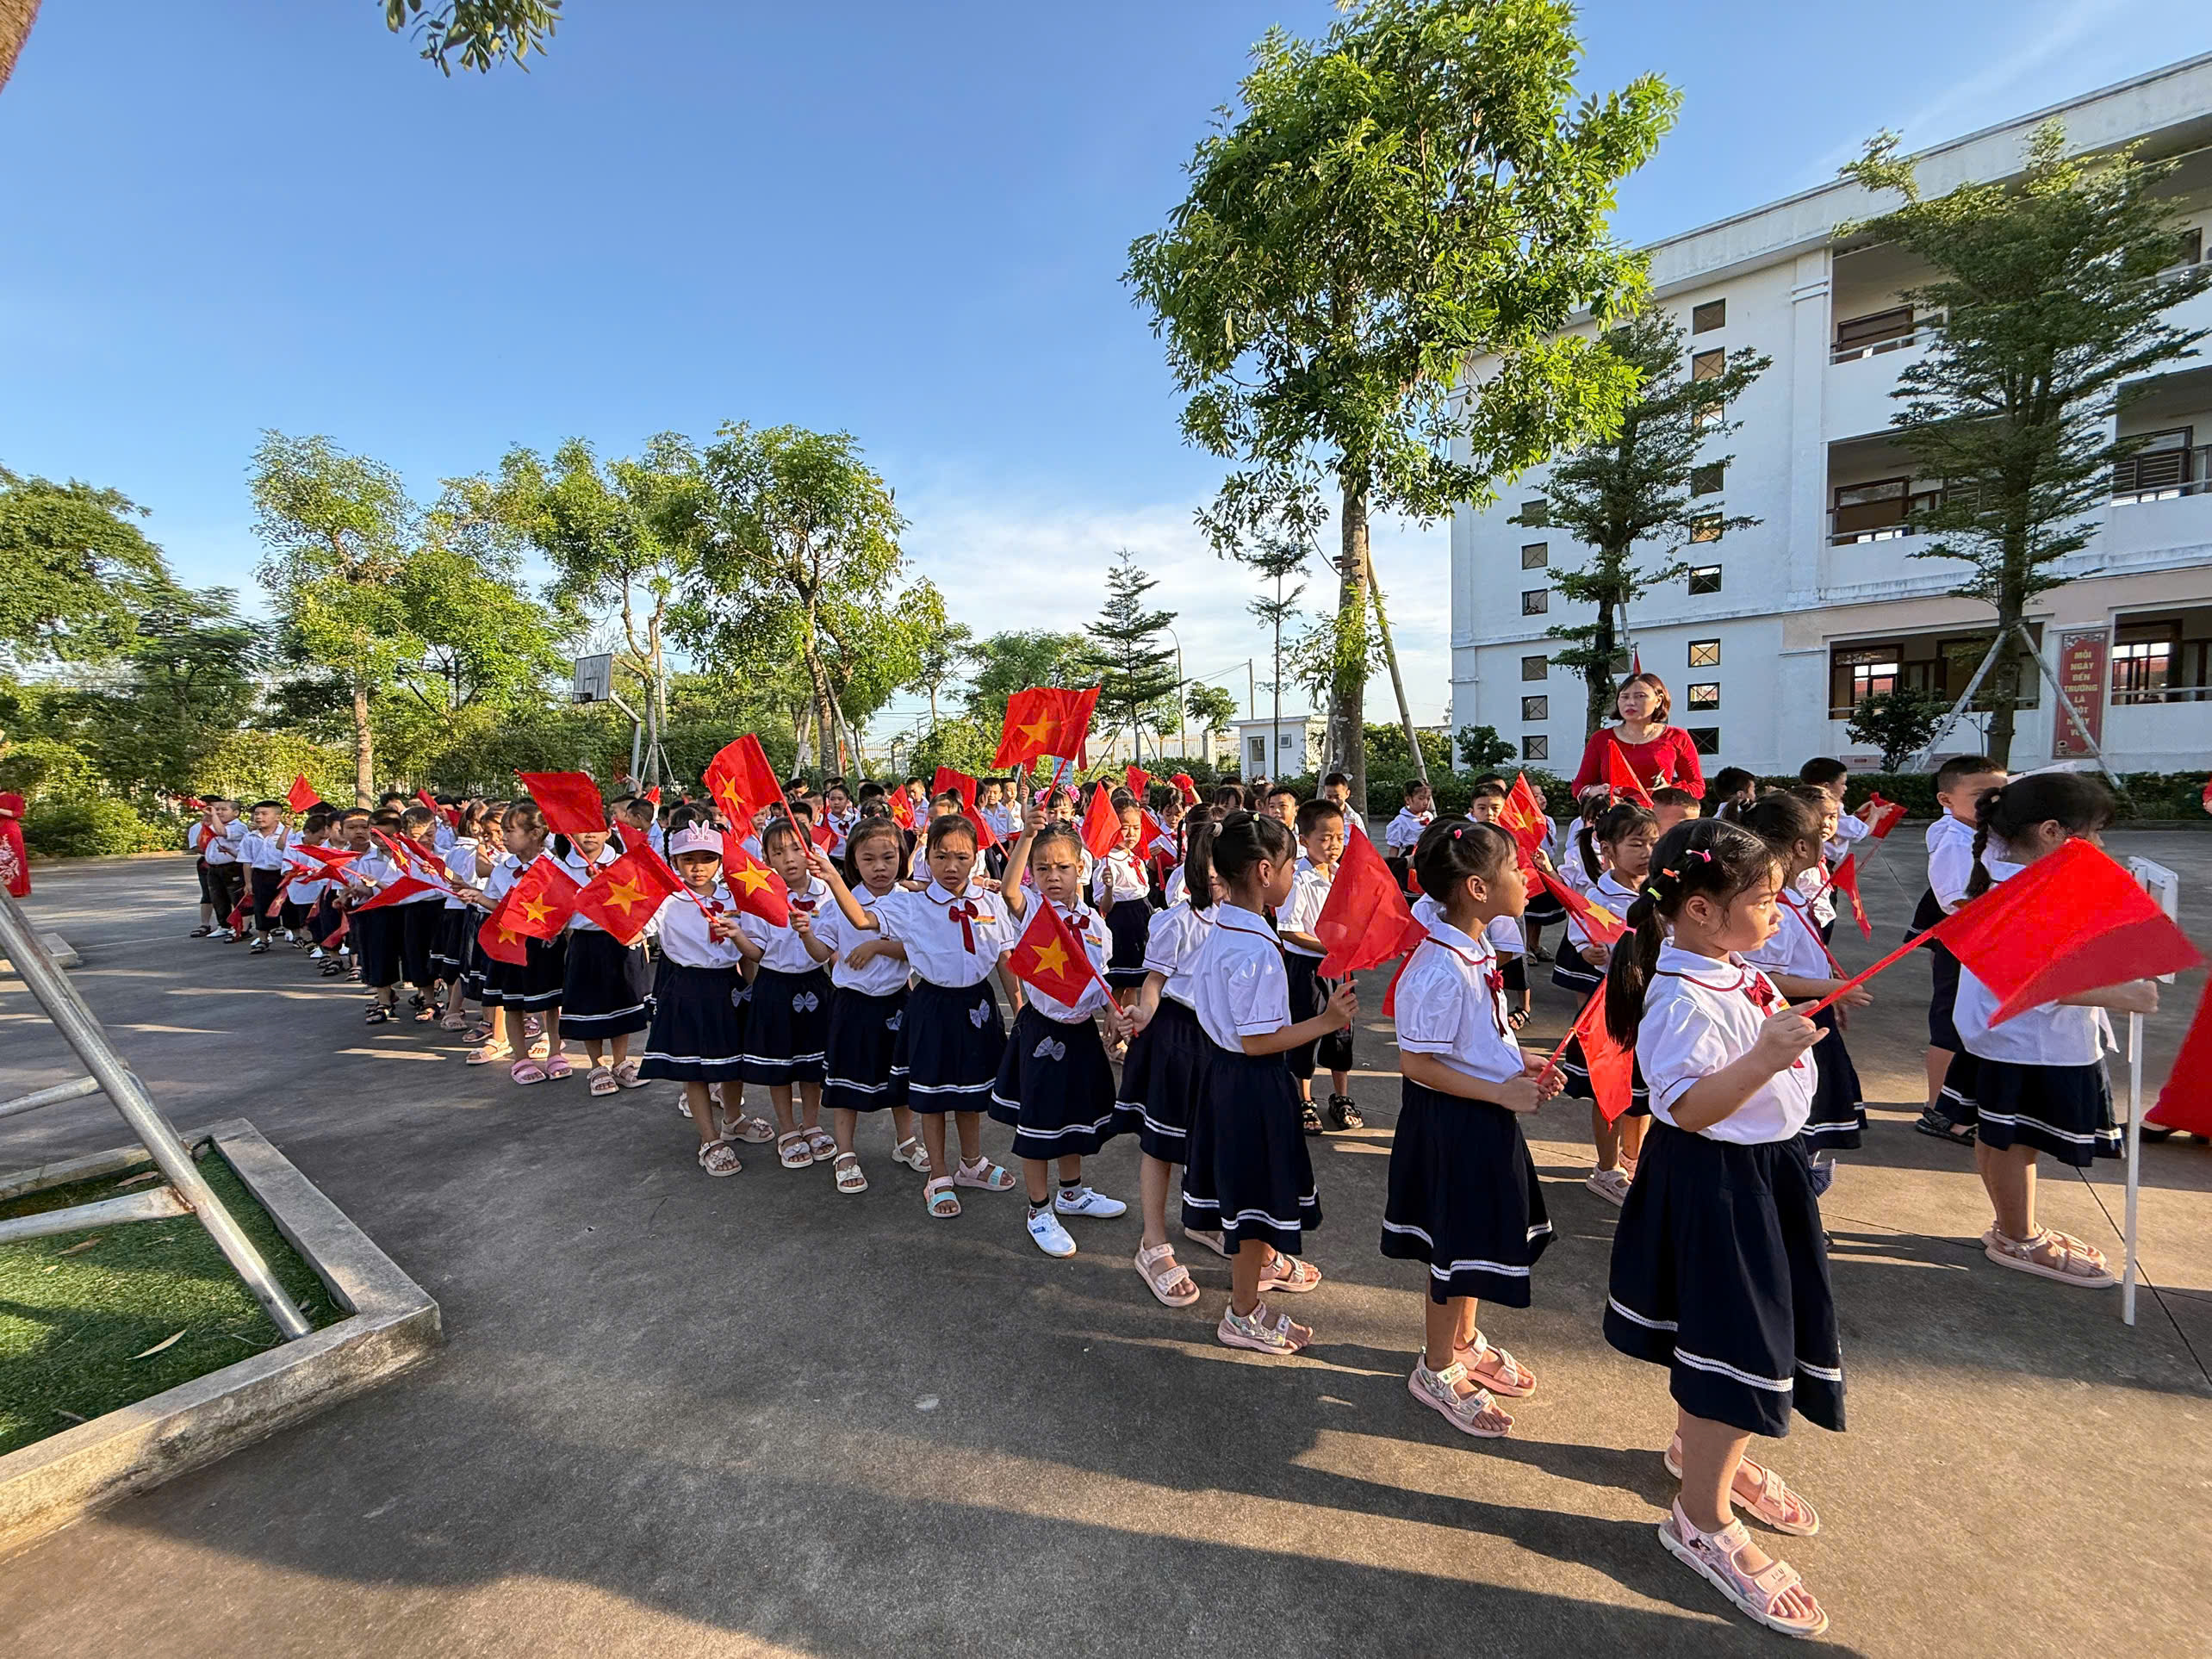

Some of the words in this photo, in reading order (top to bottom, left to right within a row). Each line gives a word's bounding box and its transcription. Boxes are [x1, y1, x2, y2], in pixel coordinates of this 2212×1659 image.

[2070, 662, 2094, 670] NGÀY
[2064, 684, 2097, 693] TRƯỜNG
[2074, 694, 2085, 703] LÀ
